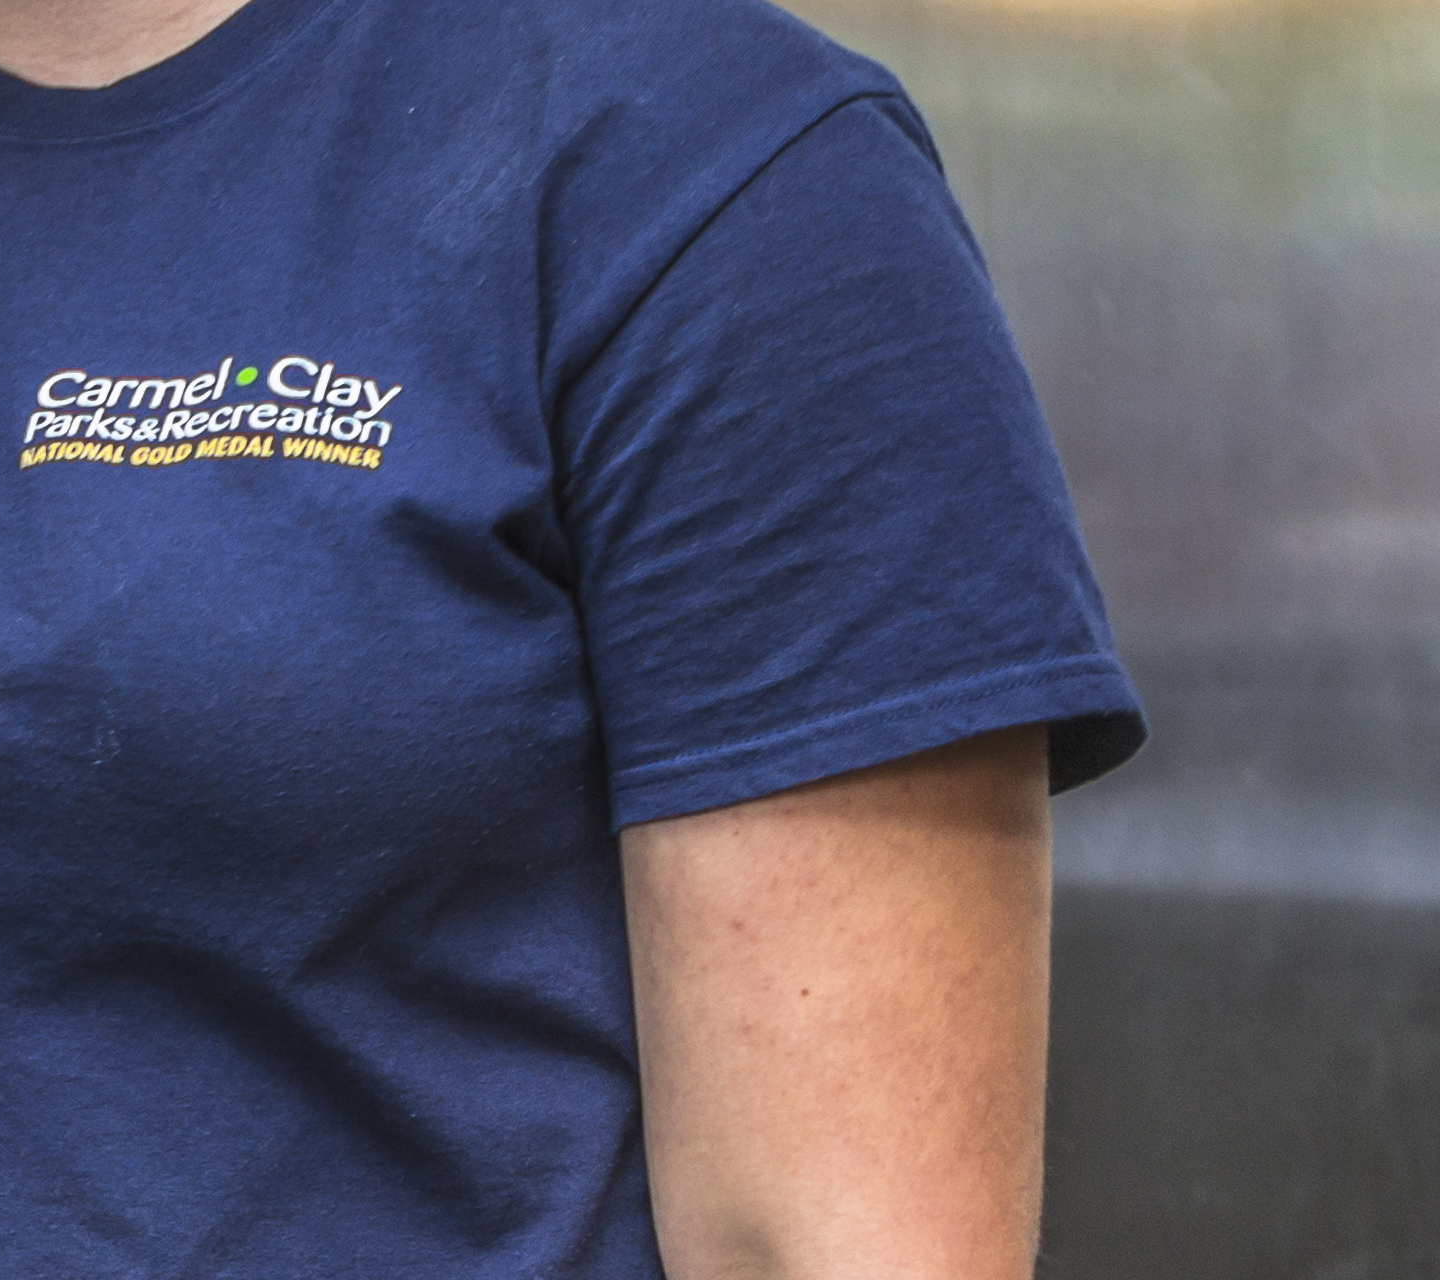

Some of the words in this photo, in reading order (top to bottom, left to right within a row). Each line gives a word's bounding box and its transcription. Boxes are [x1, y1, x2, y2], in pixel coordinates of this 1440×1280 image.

[35, 355, 235, 410] Carmel
[266, 356, 403, 420] Clay
[23, 402, 393, 448] Parks&Recreation
[19, 441, 126, 470] NATIONAL
[129, 443, 193, 467] GOLD
[194, 435, 275, 460] MEDAL
[282, 437, 382, 470] WINNER
